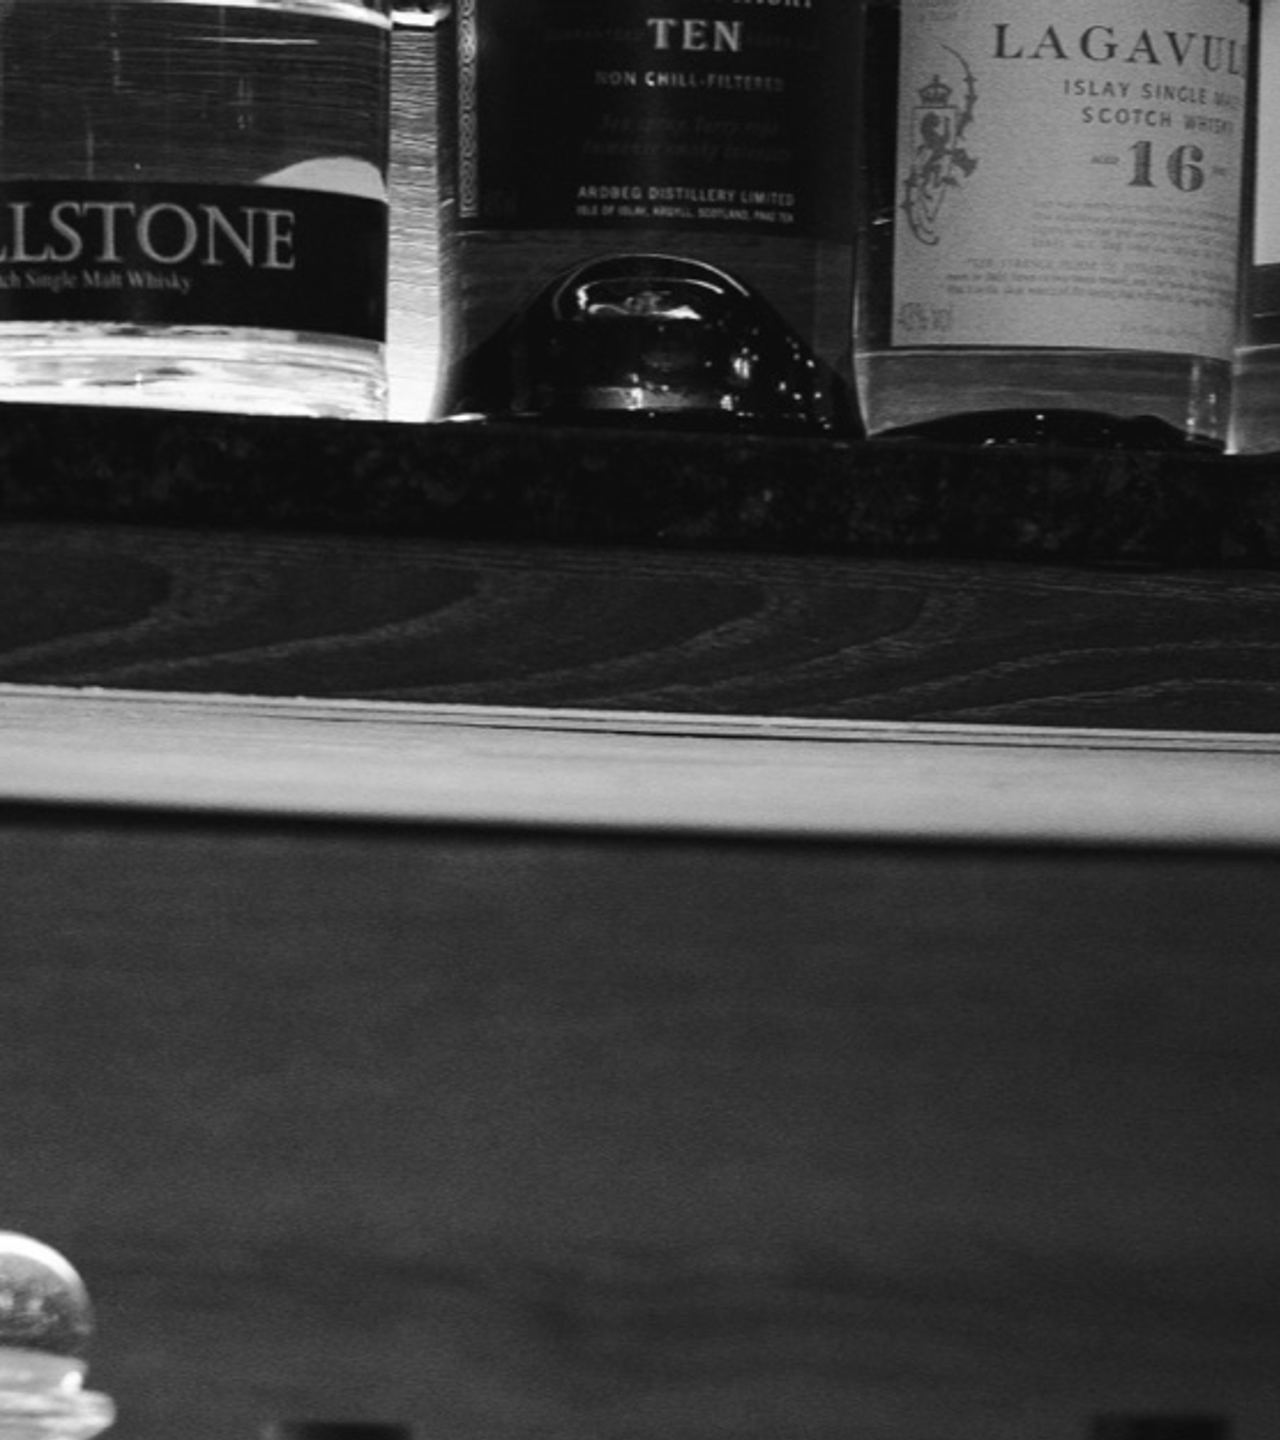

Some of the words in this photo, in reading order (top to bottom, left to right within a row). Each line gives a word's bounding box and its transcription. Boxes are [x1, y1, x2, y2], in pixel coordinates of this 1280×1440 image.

[646, 17, 744, 53] TEN
[594, 70, 637, 87] NON
[643, 70, 785, 93] CHILL-FILTERED
[1064, 79, 1131, 98] ISLAY
[1141, 82, 1208, 105] SINGLE
[1082, 106, 1173, 128] SCOTCH
[1127, 140, 1206, 193] 16
[646, 185, 736, 203] DISTILLERY
[24, 270, 78, 293] Single
[82, 270, 123, 290] Malt
[128, 270, 193, 293] Whisky
